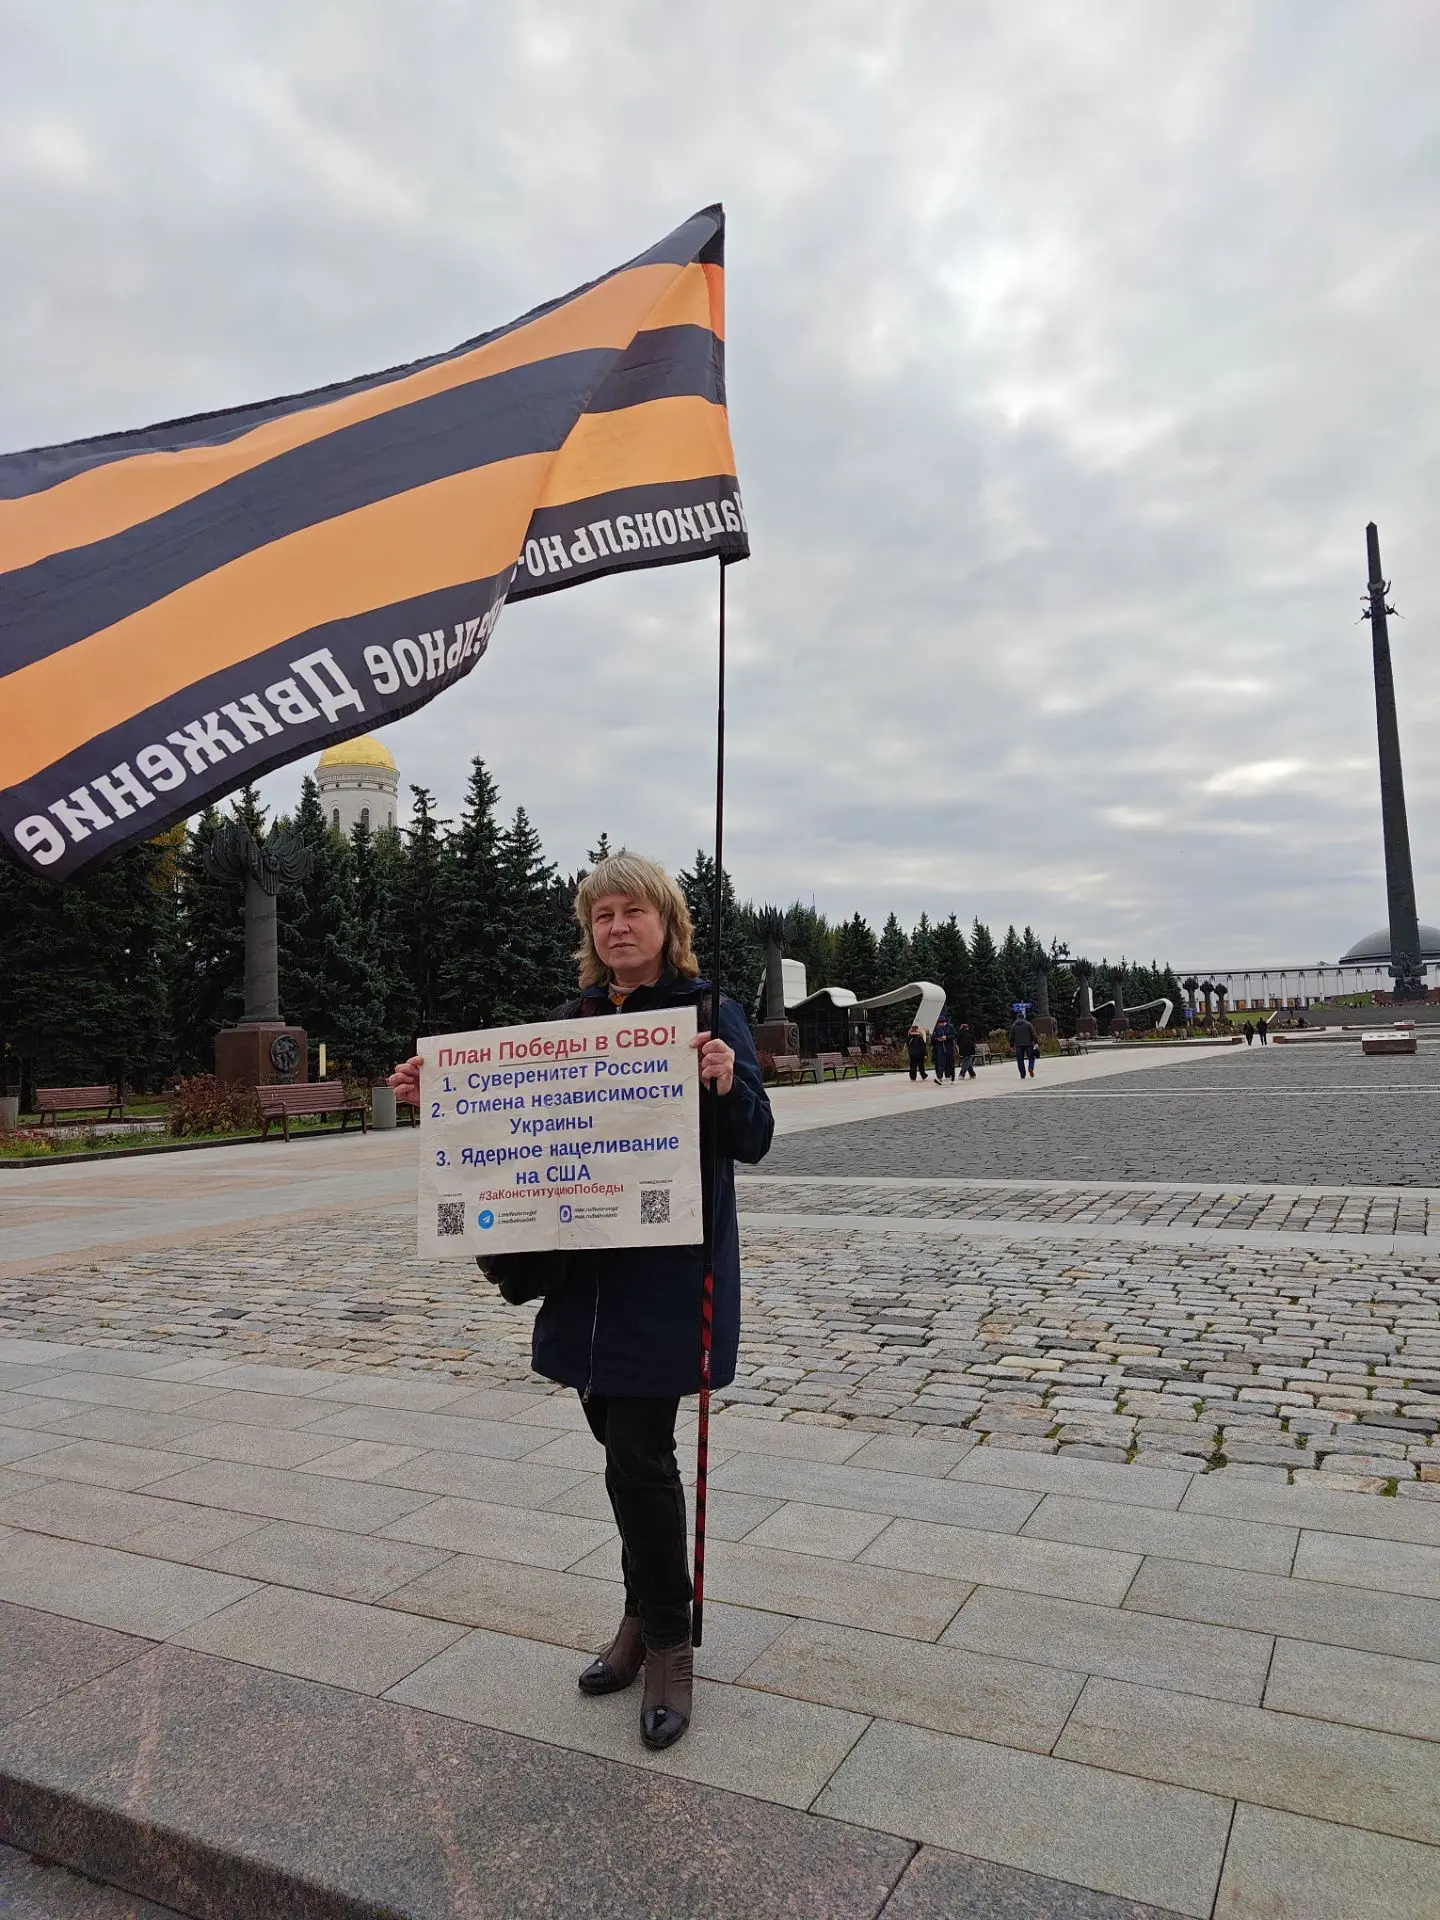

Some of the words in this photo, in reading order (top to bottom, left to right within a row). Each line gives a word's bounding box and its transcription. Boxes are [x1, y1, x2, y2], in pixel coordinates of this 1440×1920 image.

[438, 1045, 491, 1067] План
[499, 1035, 587, 1060] Победы
[595, 1034, 609, 1051] в
[615, 1025, 677, 1049] СВО!
[442, 1076, 457, 1093] 1.
[467, 1065, 588, 1093] Суверенитет
[594, 1059, 668, 1077] России
[431, 1102, 445, 1119] 2.
[456, 1094, 525, 1115] Отмена
[531, 1083, 684, 1107] независимости
[509, 1114, 593, 1136] Украины
[436, 1150, 451, 1167] 3.
[461, 1144, 543, 1167] Ядерное
[550, 1135, 680, 1157] нацеливание
[516, 1169, 540, 1185] на
[546, 1163, 591, 1183] США
[479, 1182, 624, 1202] #ЗаКонституциюПобеды
